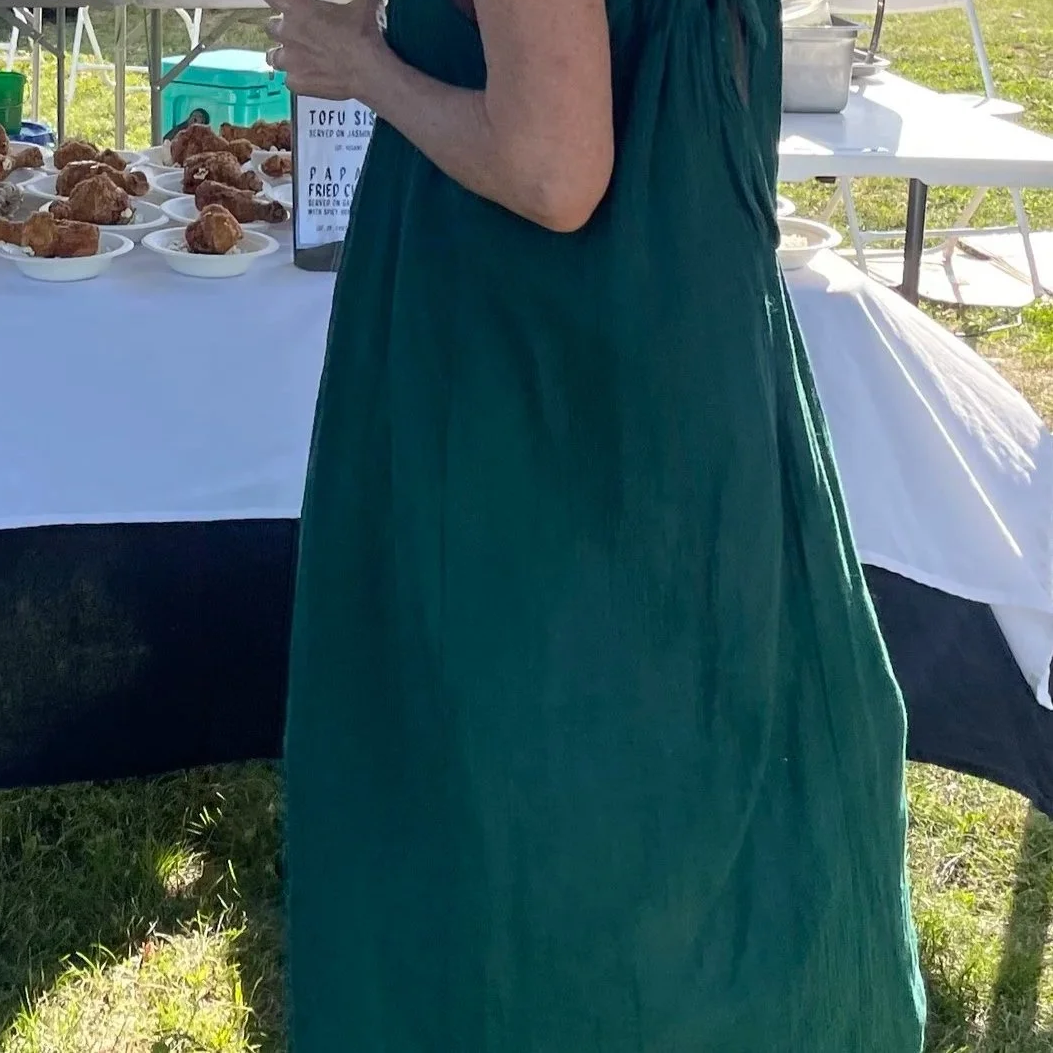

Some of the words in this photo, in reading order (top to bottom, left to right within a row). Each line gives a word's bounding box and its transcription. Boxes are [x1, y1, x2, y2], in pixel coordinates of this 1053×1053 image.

[308, 110, 345, 126] TOFU
[354, 110, 375, 126] SIS
[309, 129, 334, 138] SERVED
[335, 129, 345, 137] ON
[346, 129, 371, 138] JASMIN
[309, 166, 361, 182] PAPA
[308, 184, 340, 197] FRIED
